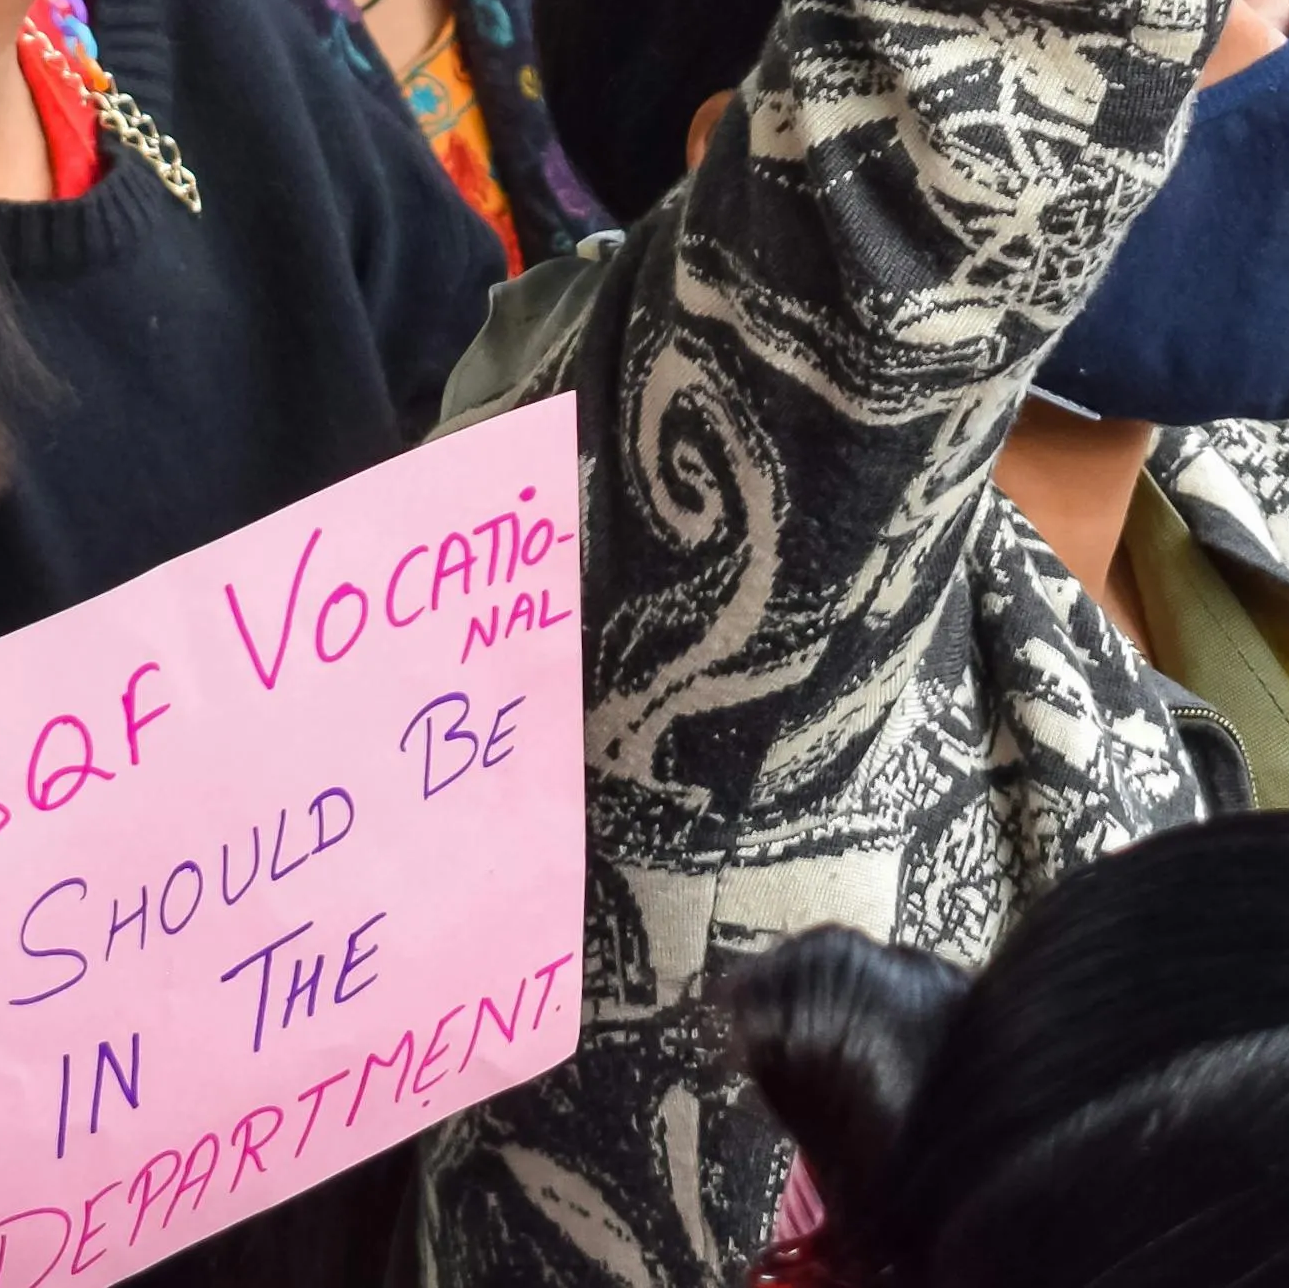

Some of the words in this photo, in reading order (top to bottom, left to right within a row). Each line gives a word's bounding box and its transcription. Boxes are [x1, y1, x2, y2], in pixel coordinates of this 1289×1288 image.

[460, 588, 573, 665] NAL
[8, 786, 356, 1007] SHOULD
[399, 690, 527, 801] BE
[55, 1032, 141, 1159] IN
[219, 911, 387, 1053] THE
